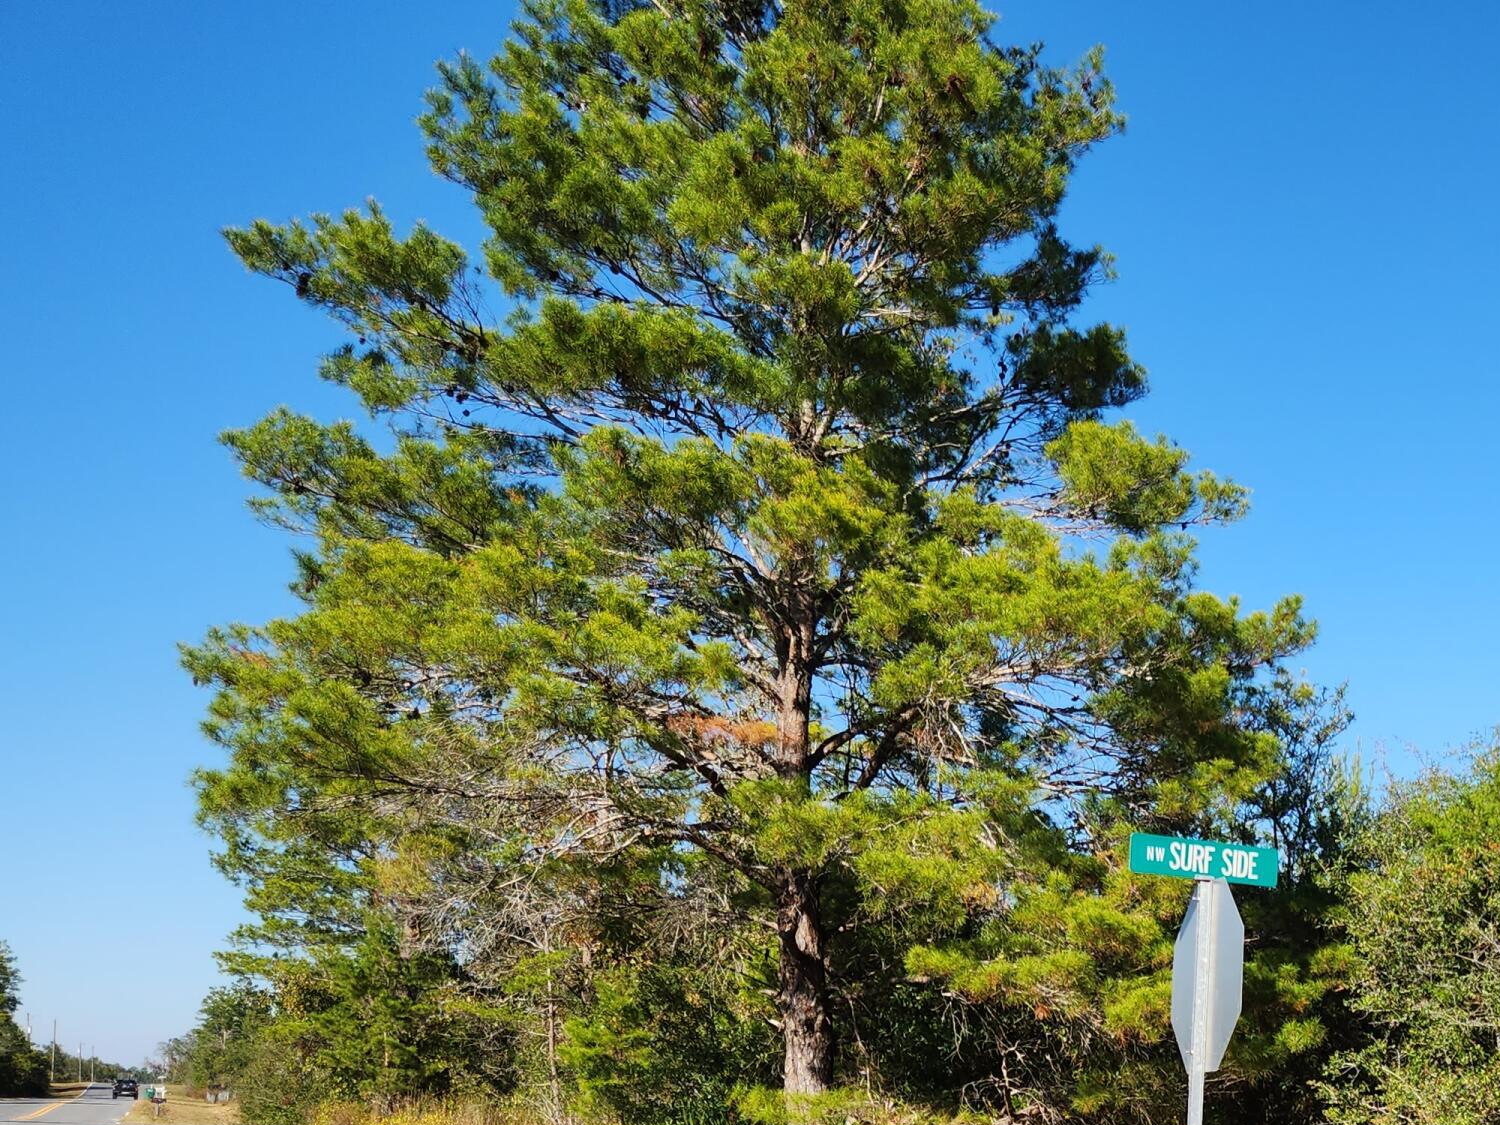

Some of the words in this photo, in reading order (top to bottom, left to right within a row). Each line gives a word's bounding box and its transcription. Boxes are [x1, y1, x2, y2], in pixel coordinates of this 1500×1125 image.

[1146, 845, 1165, 862] NW
[1169, 841, 1216, 874] SURF
[1220, 848, 1259, 880] SIDE
